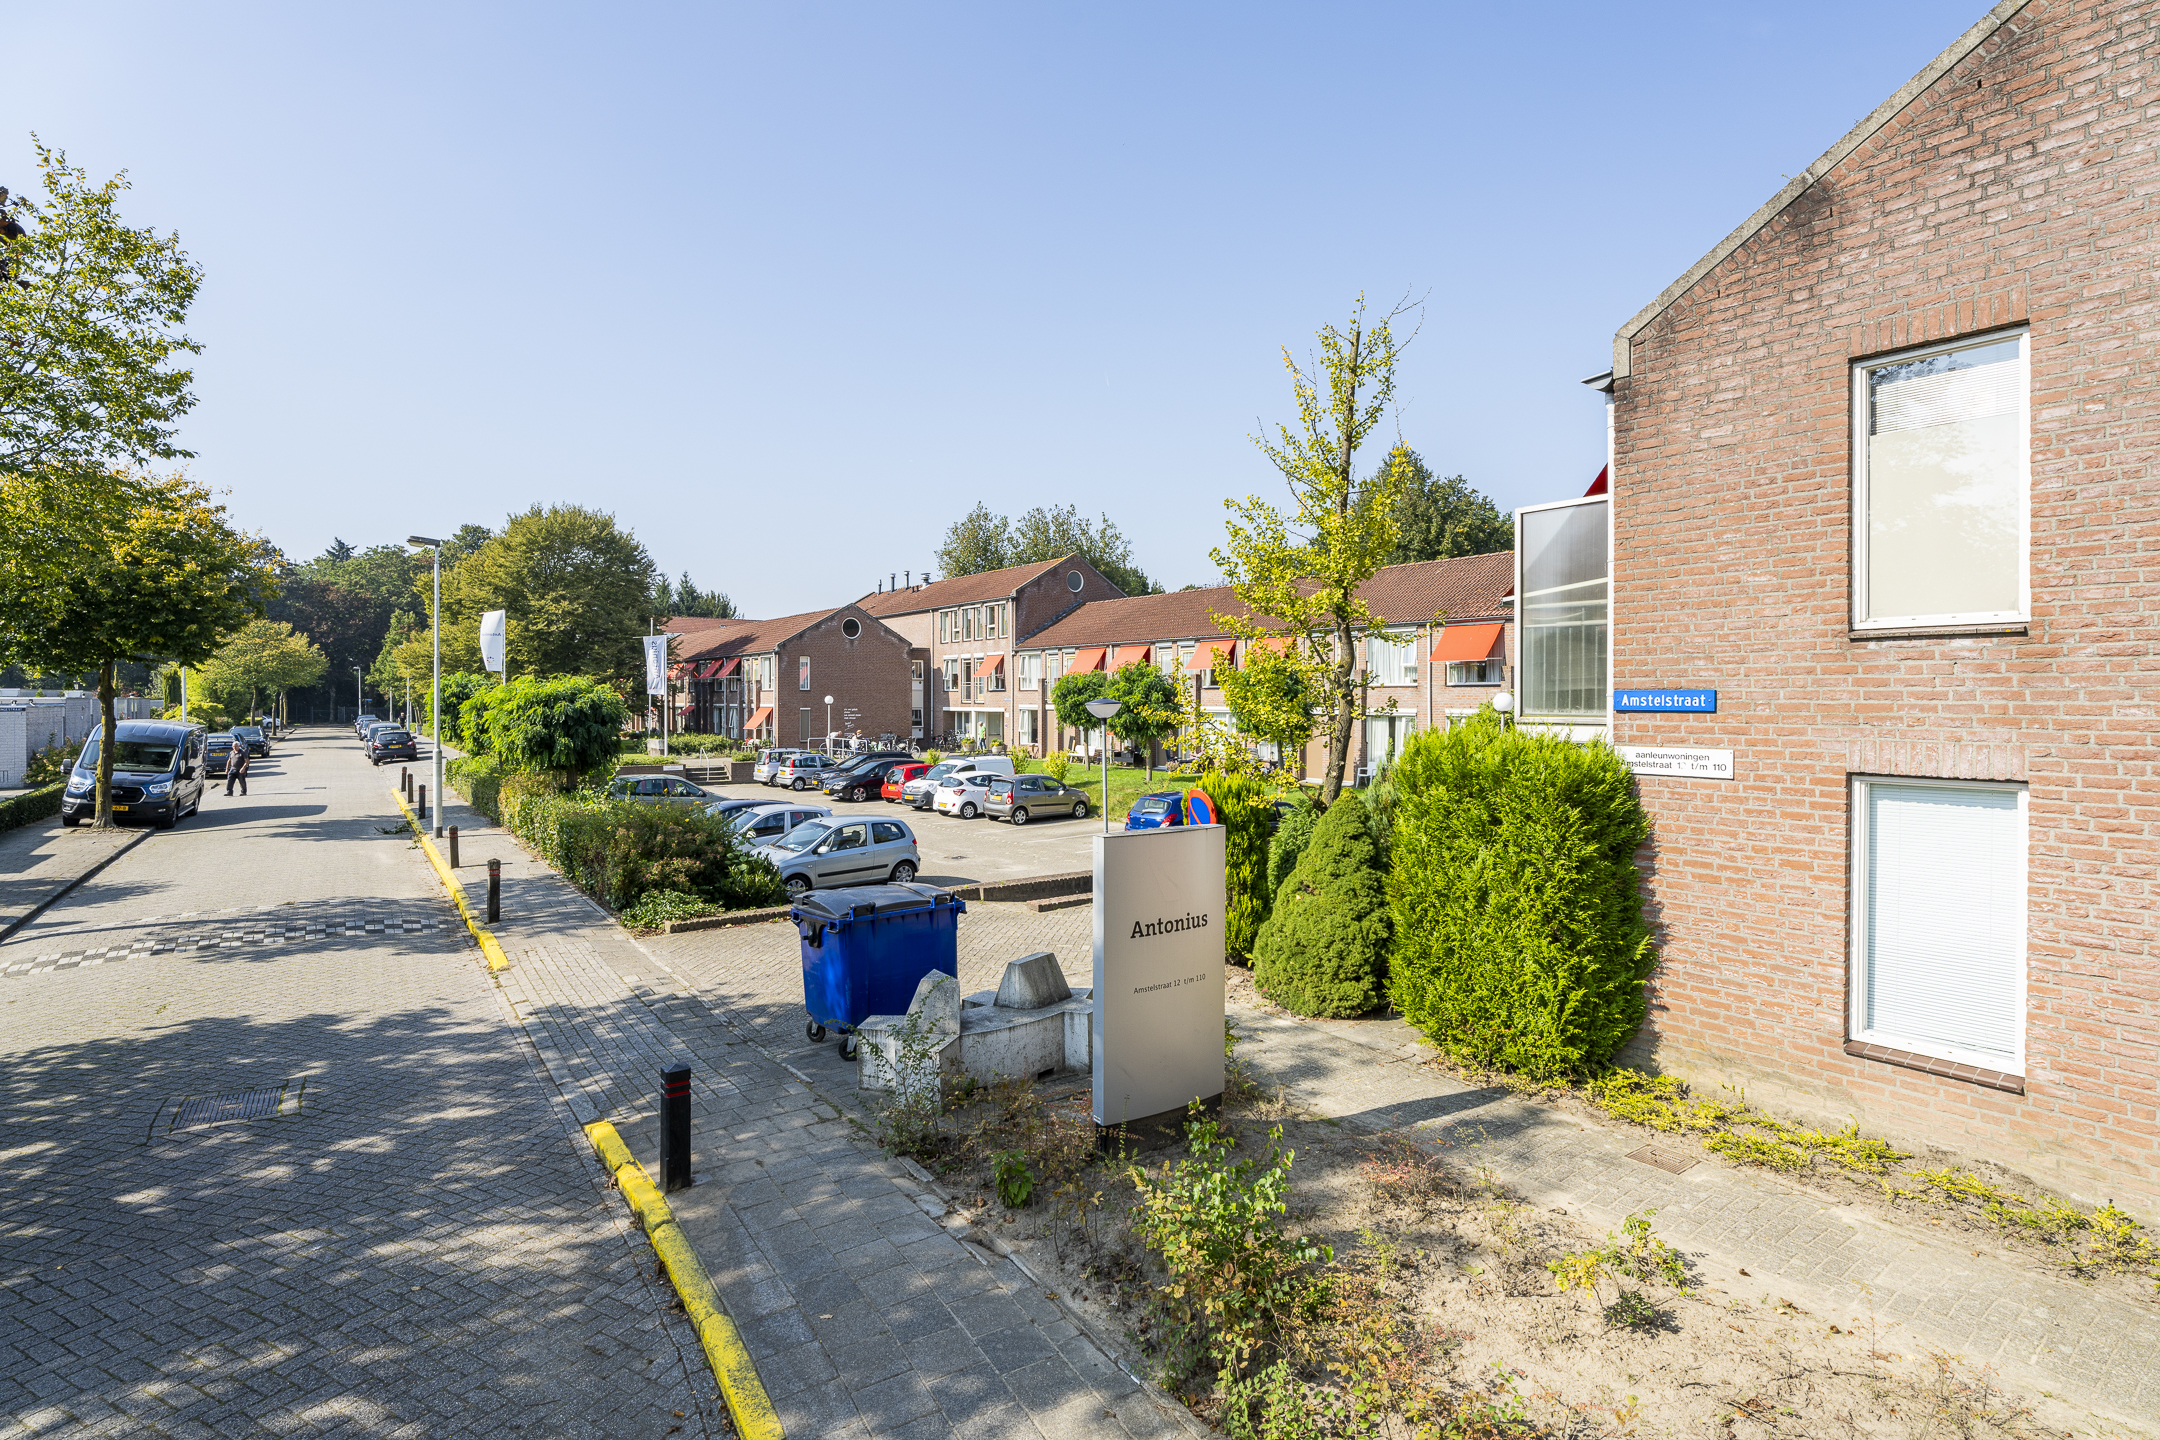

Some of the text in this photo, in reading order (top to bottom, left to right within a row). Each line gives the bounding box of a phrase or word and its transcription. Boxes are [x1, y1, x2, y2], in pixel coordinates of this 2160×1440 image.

[1621, 694, 1706, 707] Amstelstraat
[1635, 751, 1710, 762] aanleunwoningen
[1691, 763, 1708, 771] t/m
[1713, 764, 1727, 772] 110
[1130, 912, 1208, 939] Antonius
[1133, 973, 1206, 994] Amstelstraat 12 t/m 110
